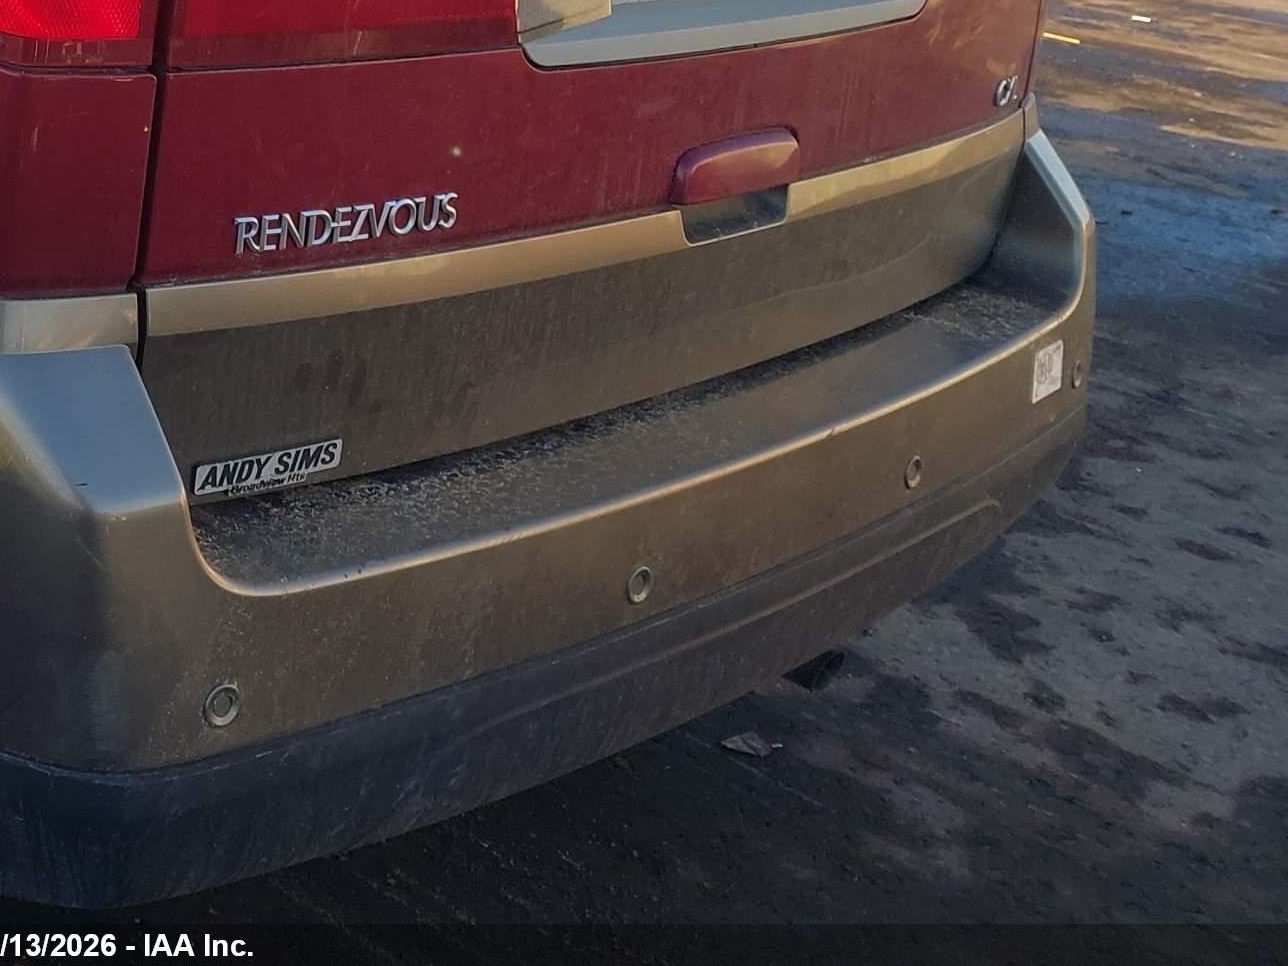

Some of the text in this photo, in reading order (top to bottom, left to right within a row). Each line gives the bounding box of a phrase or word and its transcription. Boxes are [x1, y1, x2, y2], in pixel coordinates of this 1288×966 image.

[234, 191, 459, 255] RENDEZVOUS
[197, 441, 338, 493] ANDY SIMS
